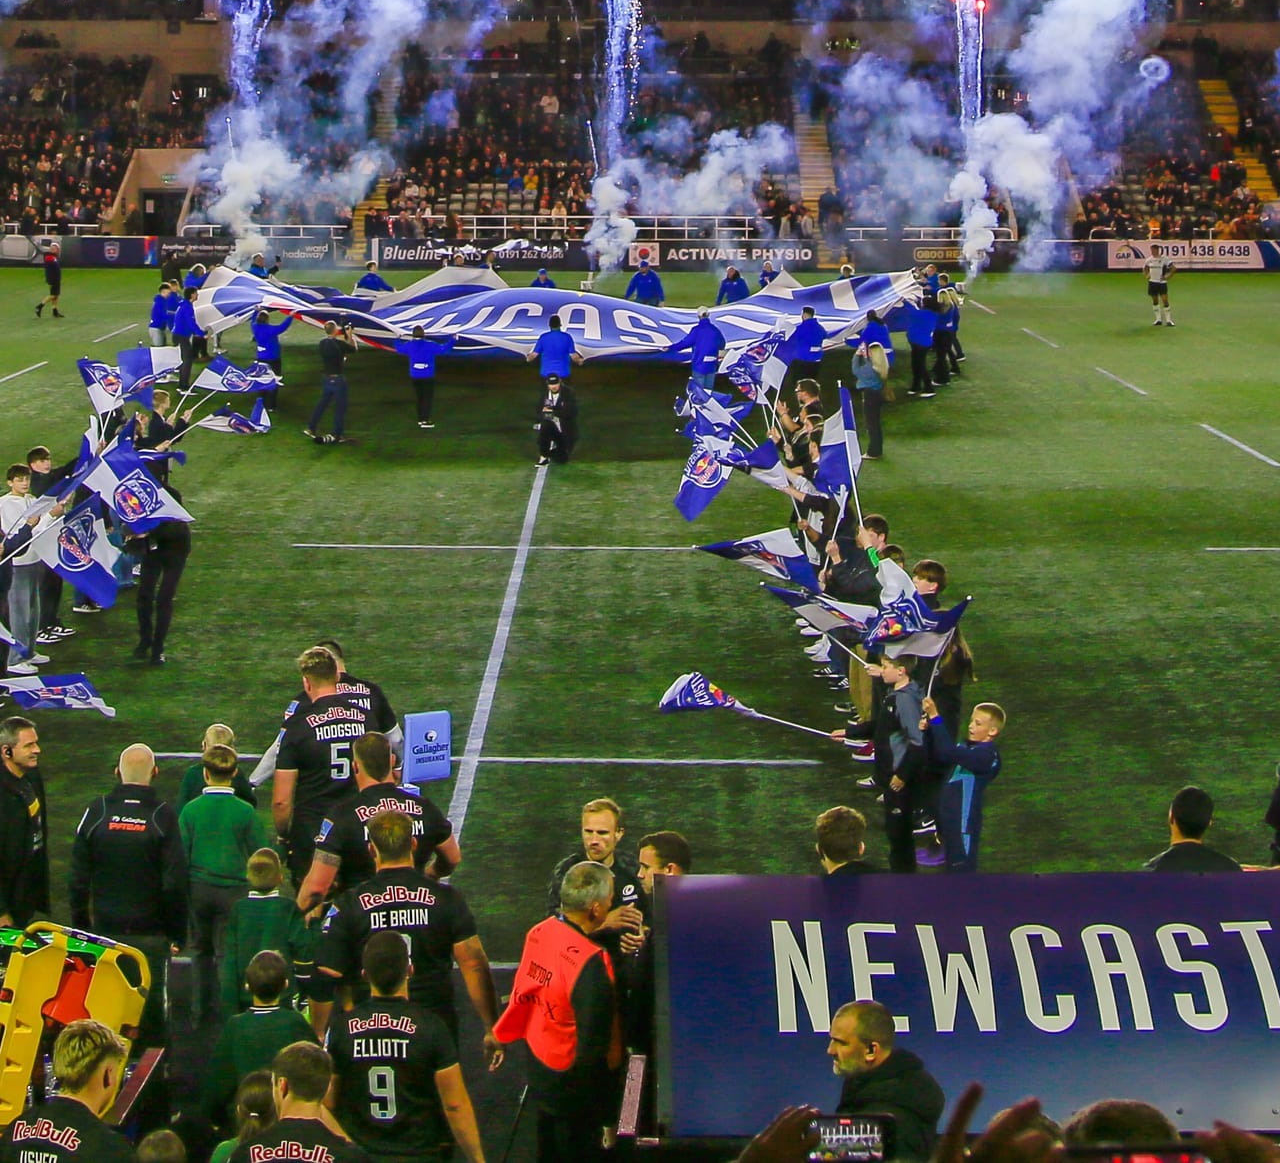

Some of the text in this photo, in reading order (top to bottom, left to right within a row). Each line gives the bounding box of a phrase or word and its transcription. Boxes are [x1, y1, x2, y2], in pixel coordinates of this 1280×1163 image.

[282, 249, 325, 260] hadaway
[305, 243, 329, 253] ward
[383, 245, 442, 261] Blueline
[498, 249, 520, 259] 0191
[521, 250, 538, 259] 262
[667, 248, 812, 260] ACTIVATE PHYSIO
[1115, 252, 1131, 260] GAP
[1190, 245, 1214, 256] 438
[1218, 245, 1251, 256] 6438
[315, 723, 366, 741] HODGSON
[412, 742, 449, 755] Gallagher
[330, 742, 350, 780] 5
[415, 754, 445, 764] INSURANCE
[370, 908, 429, 930] DE BRUIN
[526, 960, 553, 988] DOCTOR
[353, 1038, 410, 1058] ELLIOTT
[367, 1065, 397, 1119] 9
